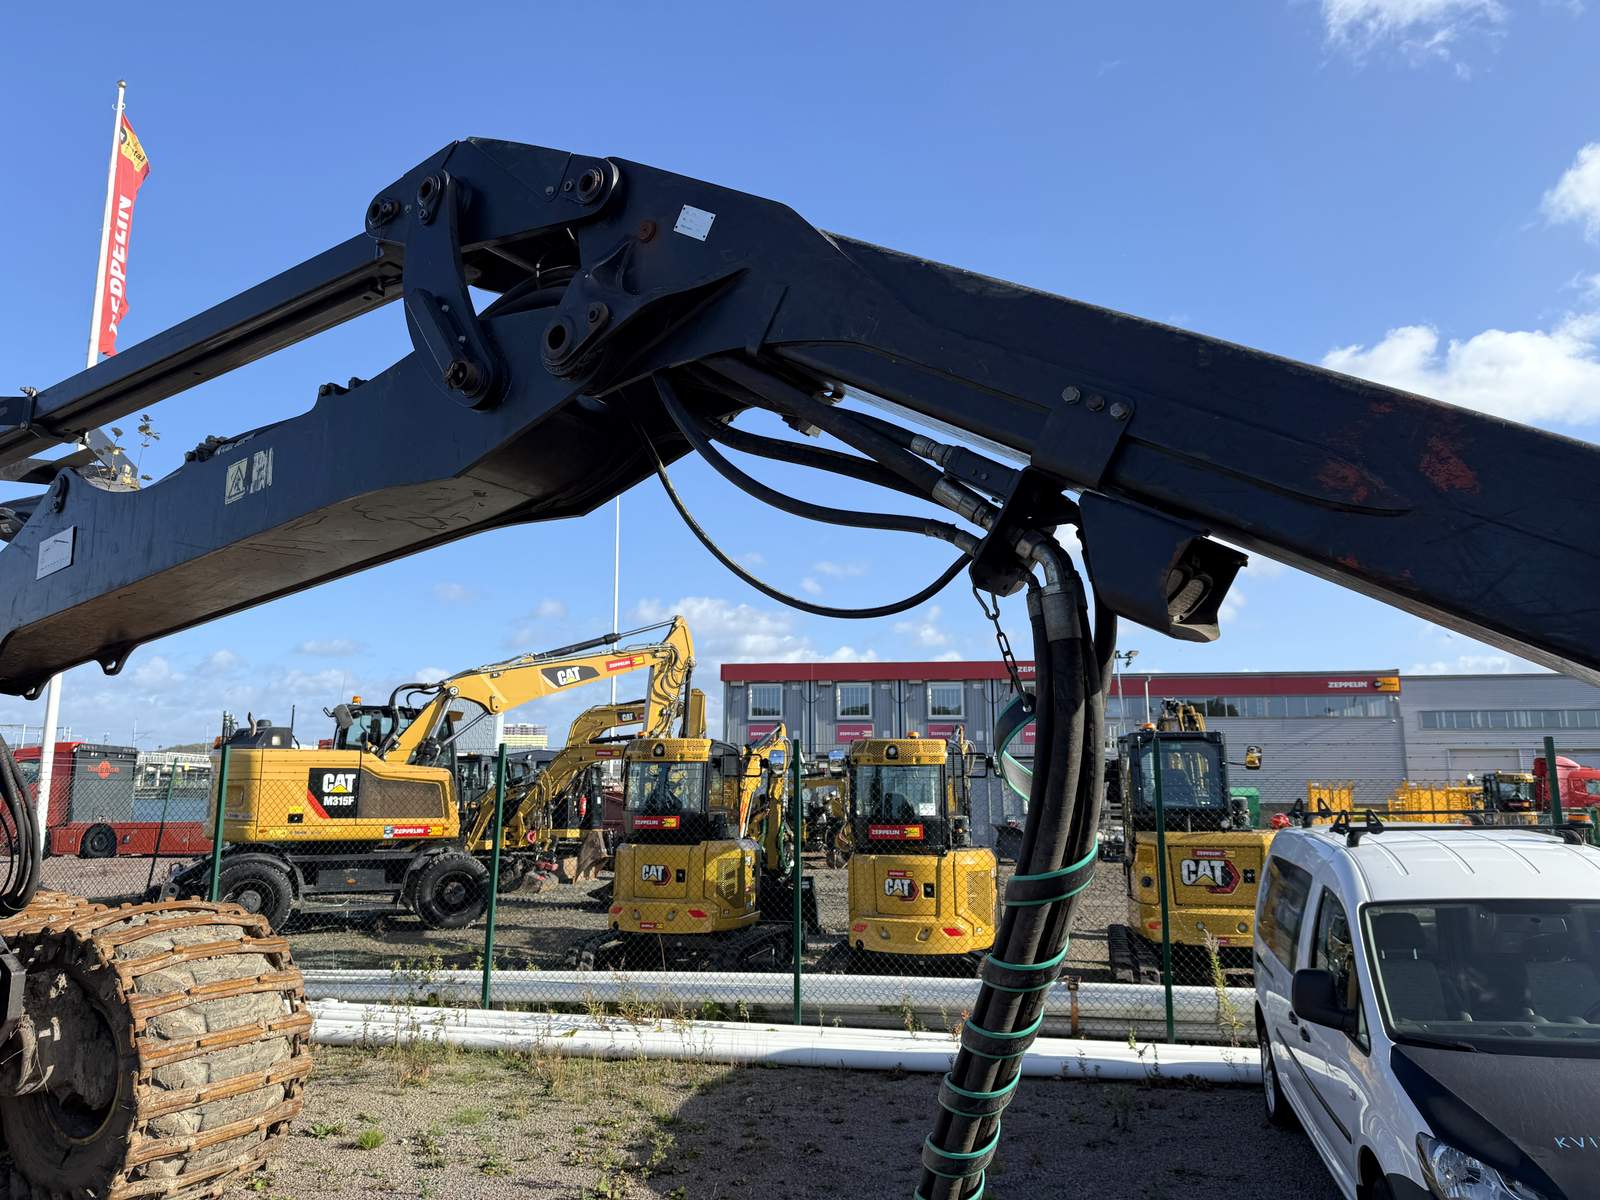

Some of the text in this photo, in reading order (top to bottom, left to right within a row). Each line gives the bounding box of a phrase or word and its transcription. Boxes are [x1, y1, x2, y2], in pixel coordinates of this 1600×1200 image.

[557, 666, 581, 686] CAT
[1327, 681, 1368, 689] ZEPPELIN
[621, 713, 634, 721] CAT
[322, 773, 356, 793] CAT
[323, 795, 354, 806] M315F
[642, 864, 665, 881] CAT
[1181, 859, 1225, 886] CAT
[884, 879, 911, 896] CAT
[1553, 1136, 1600, 1149] KVI
